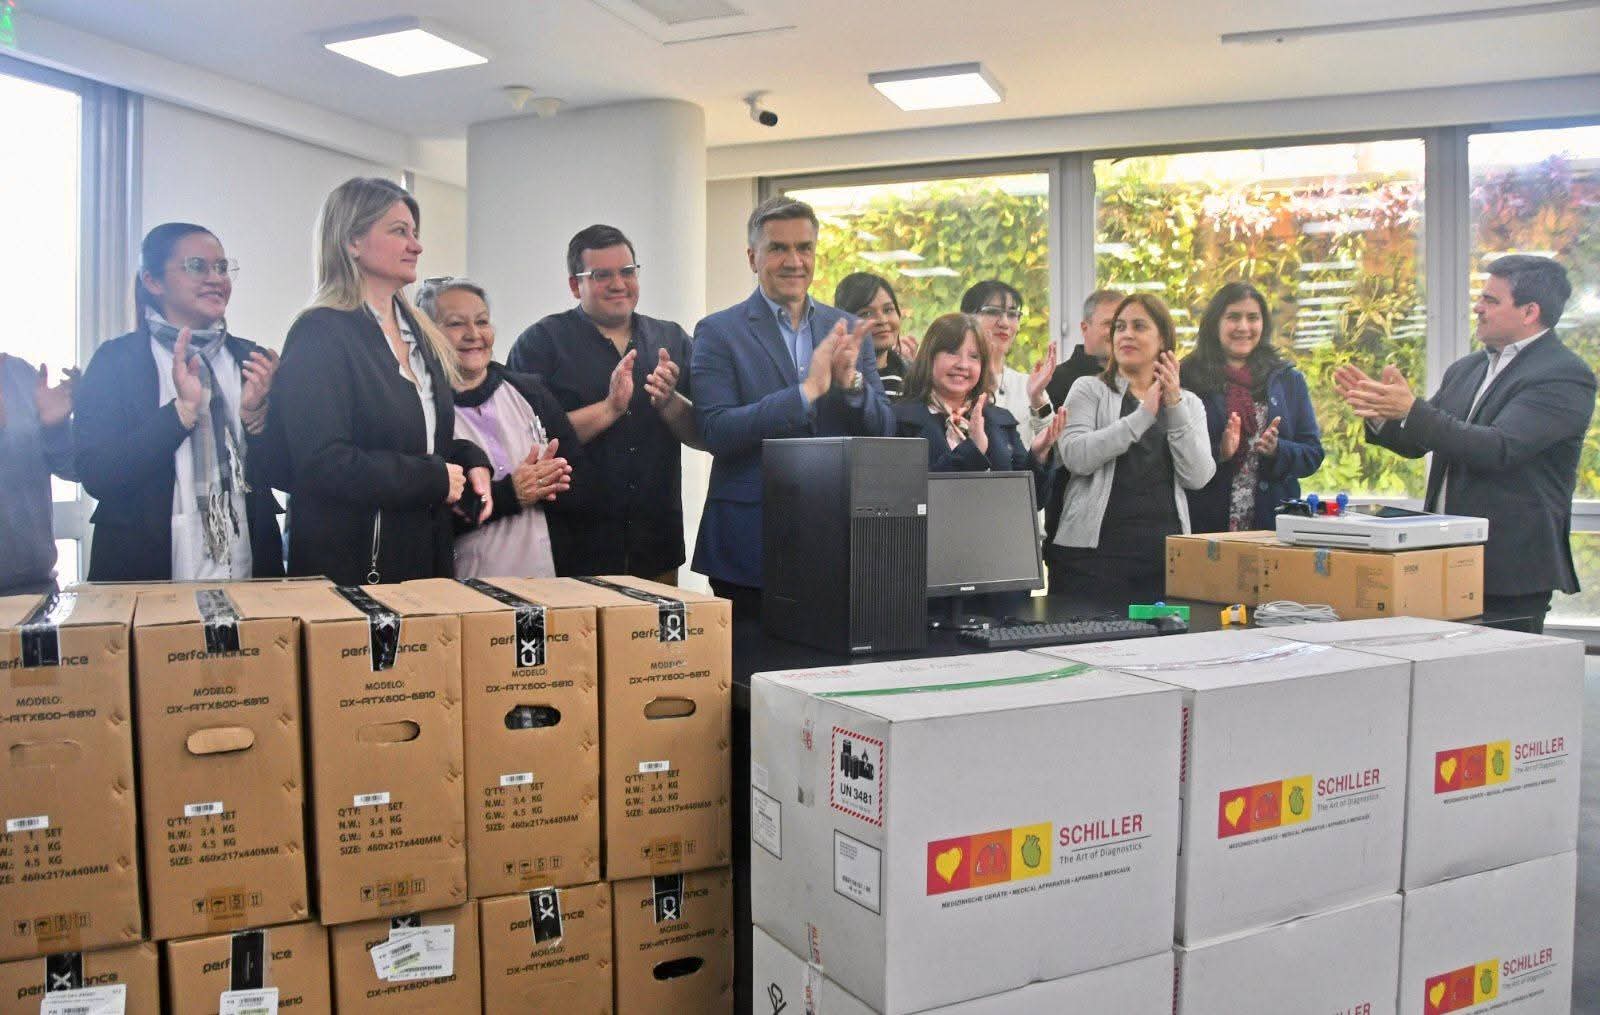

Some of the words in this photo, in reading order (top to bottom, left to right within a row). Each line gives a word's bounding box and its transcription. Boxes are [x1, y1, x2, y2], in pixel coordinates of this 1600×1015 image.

[1514, 736, 1564, 761] SCHILLER
[1317, 768, 1380, 797] SCHILLER
[532, 793, 543, 803] KG
[840, 782, 852, 798] UN
[853, 787, 873, 806] 3481
[532, 806, 543, 815] KG
[390, 814, 402, 824] KG
[223, 824, 236, 834] KG
[391, 827, 403, 836] KG
[1059, 813, 1143, 847] SCHILLER
[48, 841, 61, 851] KG
[224, 838, 236, 847] KG
[1059, 855, 1074, 865] The
[1075, 852, 1088, 862] Art
[1089, 850, 1099, 860] of
[1100, 842, 1143, 857] Diagnostics
[48, 856, 62, 865] KG
[1502, 947, 1553, 978] SCHILLER
